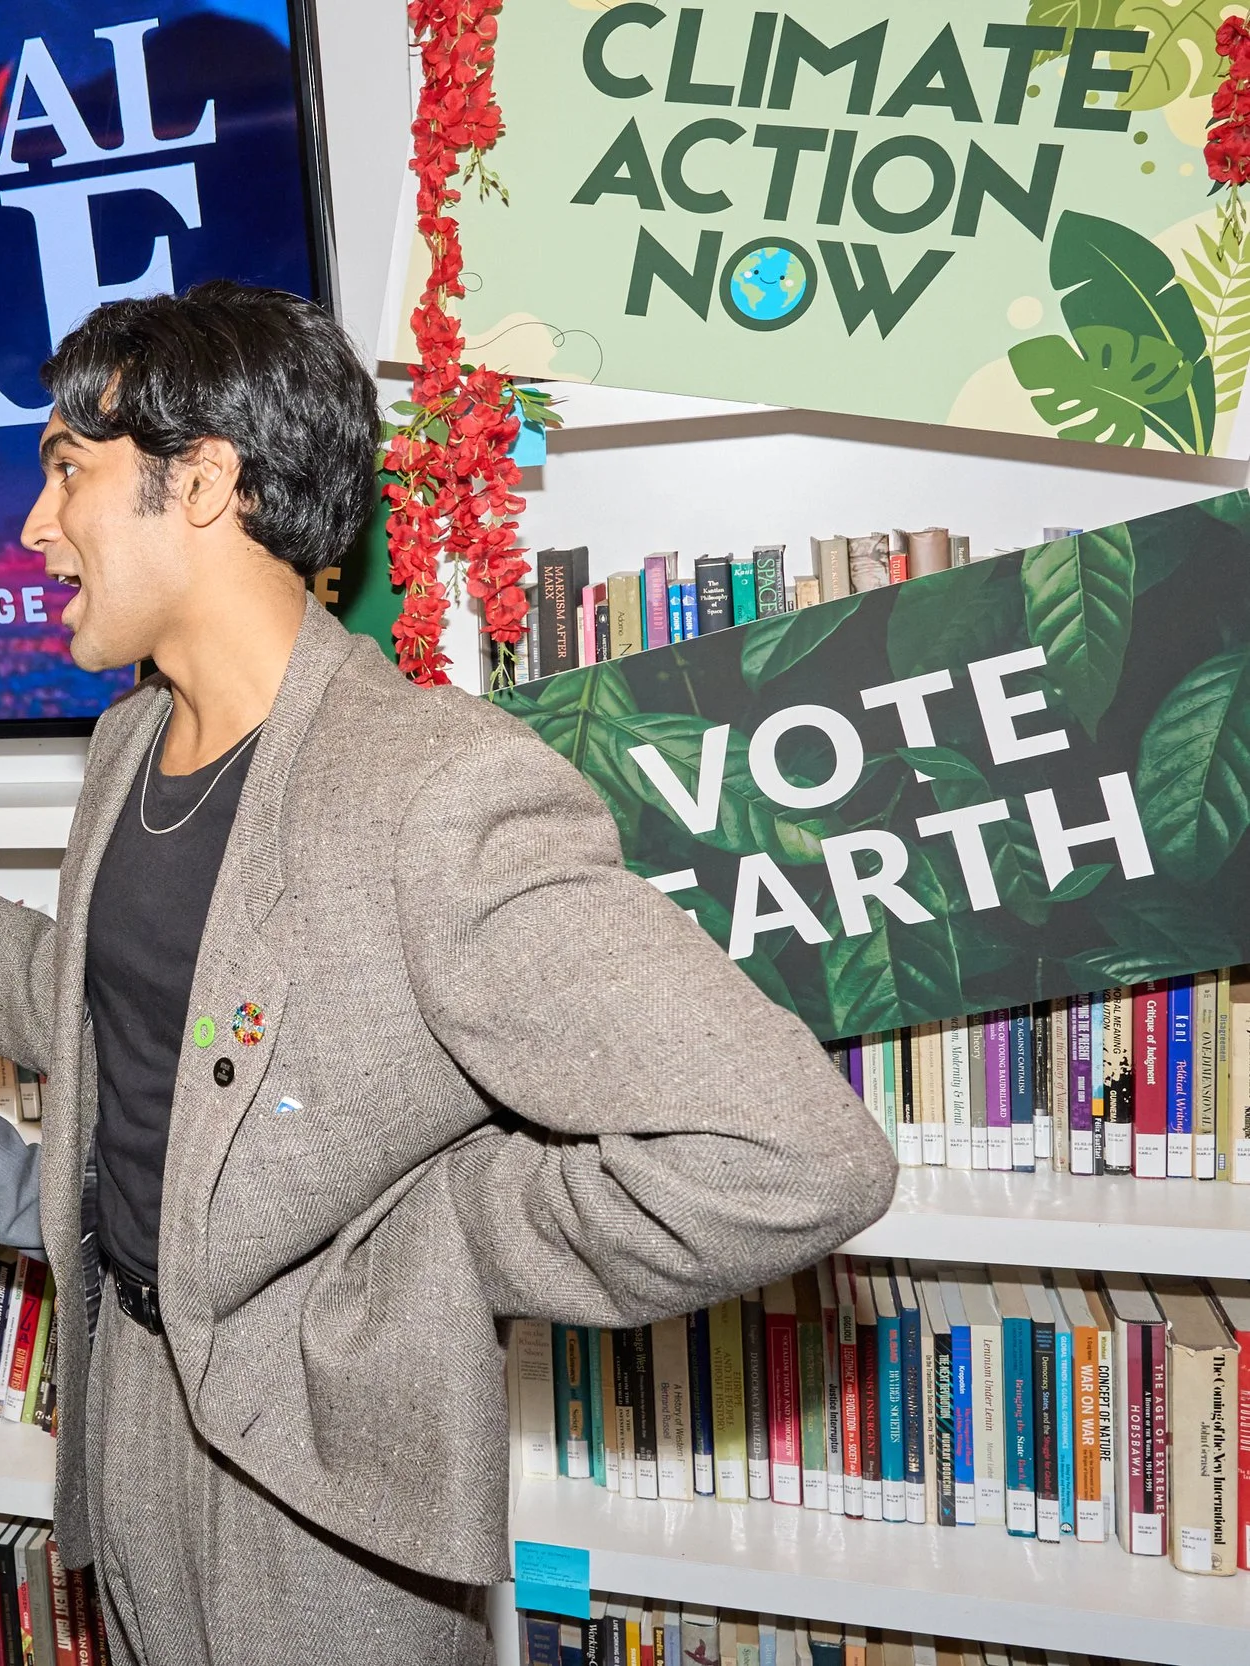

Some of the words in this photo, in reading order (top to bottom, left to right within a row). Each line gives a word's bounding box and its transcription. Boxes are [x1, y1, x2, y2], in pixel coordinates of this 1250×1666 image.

[582, 2, 1149, 132] CLIMATE
[570, 115, 1064, 243] ACTION
[625, 225, 955, 341] NOW
[544, 566, 554, 600] MARX
[554, 566, 565, 620] MARXISM
[756, 558, 778, 613] SPACE
[617, 611, 626, 637] Adorno
[707, 608, 723, 616] Space
[557, 623, 567, 658] AFTER
[627, 645, 1070, 837] VOTE
[1077, 1020, 1091, 1032] THE
[1145, 1000, 1158, 1032] Critique
[1175, 1015, 1188, 1042] Kant
[972, 1028, 983, 1060] Theory
[998, 1033, 1006, 1043] OF
[1017, 1027, 1025, 1056] AGAINST
[1078, 1033, 1091, 1061] PRESENT
[1113, 1015, 1122, 1054] MEANING
[1147, 1035, 1158, 1044] of
[1218, 1014, 1228, 1062] Disagreement
[951, 1045, 963, 1088] Modernity
[998, 1043, 1006, 1068] YOUNG
[1054, 1054, 1067, 1080] Theory
[1145, 1045, 1158, 1085] Judgment
[1017, 1056, 1025, 1094] CAPITALISM
[1055, 1081, 1067, 1091] of
[1175, 1060, 1188, 1095] Political
[1200, 1031, 1213, 1127] ONE-DIMENSIONAL
[954, 1090, 963, 1098] &
[999, 1069, 1007, 1118] BAUDRILLARD
[14, 1348, 26, 1369] GLORIA
[782, 1335, 791, 1372] SOCIALISM
[939, 1354, 951, 1366] THE
[983, 1339, 994, 1378] Leninism
[1060, 1335, 1068, 1358] GLOBAL
[636, 1354, 647, 1373] West
[714, 1347, 723, 1390] WITHOUT
[723, 1353, 732, 1373] AND
[844, 1348, 855, 1383] LEGITIMACY
[939, 1366, 951, 1382] NEXT
[1040, 1356, 1050, 1391] Democracy,
[1061, 1359, 1069, 1381] TRENDS
[1154, 1364, 1164, 1389] THE
[1213, 1354, 1226, 1376] The
[724, 1375, 733, 1393] THE
[733, 1371, 742, 1407] EUROPE
[750, 1352, 760, 1408] DEMOCRACY
[783, 1373, 792, 1401] TODAY
[889, 1370, 900, 1402] DIVIDED
[957, 1365, 966, 1394] Kropotkin
[1081, 1364, 1094, 1391] WAR
[1098, 1365, 1110, 1408] CONCEPT
[661, 1382, 671, 1413] Bertrand
[673, 1391, 684, 1416] History
[829, 1383, 838, 1410] Justice
[940, 1383, 951, 1419] REVOLUTION
[984, 1379, 995, 1406] Under
[1013, 1379, 1024, 1417] Bringing
[1041, 1392, 1051, 1411] States,
[1061, 1388, 1069, 1410] GLOBAL
[1082, 1396, 1094, 1414] ON
[1210, 1378, 1226, 1421] Coming
[570, 1408, 580, 1432] Society
[675, 1418, 684, 1426] of
[716, 1393, 726, 1432] HISTORY
[725, 1394, 735, 1425] PEOPLE
[784, 1401, 792, 1415] AND
[845, 1393, 857, 1431] REVOLUTION
[984, 1408, 995, 1432] Lenin
[1043, 1412, 1051, 1424] and
[1099, 1410, 1111, 1422] OF
[1155, 1396, 1164, 1421] AGE
[663, 1414, 673, 1439] Russell
[752, 1411, 761, 1454] REALIZED
[784, 1417, 793, 1456] TOMORROW
[829, 1411, 840, 1454] Interruptus
[867, 1399, 876, 1455] INSURGENT
[889, 1405, 901, 1443] SOCIETIES
[1016, 1419, 1025, 1433] the
[1043, 1425, 1051, 1435] the
[1062, 1411, 1070, 1449] GOVERNANCE
[1082, 1418, 1095, 1446] WAR
[1155, 1428, 1165, 1444] OF
[1200, 1421, 1211, 1444] John
[1213, 1422, 1226, 1434] of
[676, 1428, 684, 1457] Western
[848, 1443, 857, 1464] SOCIETY
[941, 1433, 951, 1460] MURRAY
[1016, 1436, 1026, 1457] State
[1042, 1436, 1052, 1460] Struggle
[1100, 1425, 1112, 1462] NATURE
[1130, 1404, 1142, 1477] HOBSBAWM
[1213, 1433, 1226, 1452] the
[1200, 1444, 1211, 1477] Gerassi
[1213, 1452, 1227, 1475] New
[942, 1462, 952, 1496] BOOKCHIN
[1155, 1452, 1165, 1517] EXTREMES
[1213, 1477, 1227, 1545] International
[53, 1587, 69, 1617] NEXT
[75, 1587, 88, 1649] PROLETARIAN
[612, 1619, 620, 1631] LIVE
[55, 1618, 72, 1651] GIANT
[613, 1632, 621, 1655] WORKING
[614, 1656, 621, 1664] OR
